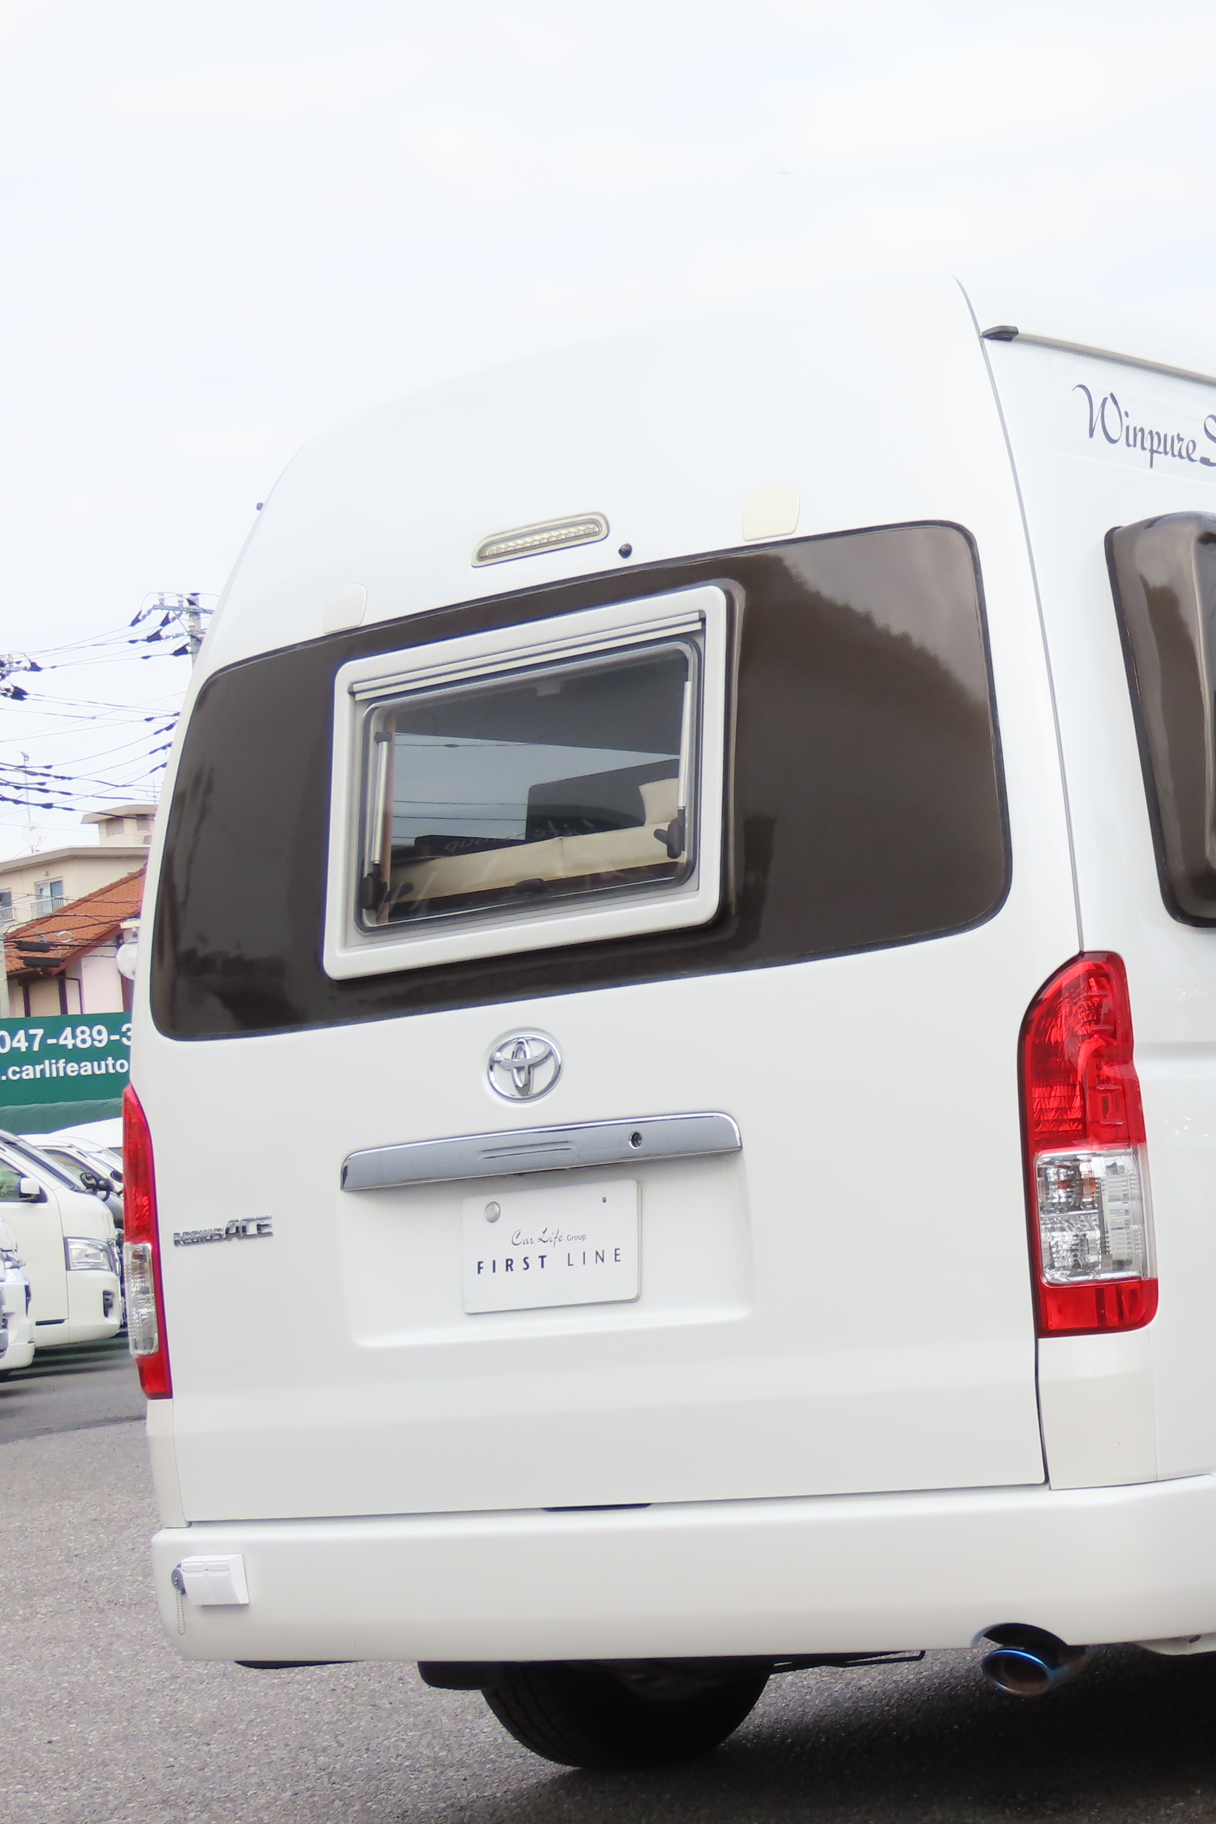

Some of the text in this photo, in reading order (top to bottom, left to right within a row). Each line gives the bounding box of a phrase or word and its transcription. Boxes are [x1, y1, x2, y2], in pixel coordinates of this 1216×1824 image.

[511, 1227, 587, 1248] Car Life Group
[477, 1247, 622, 1275] FIRST LINE
